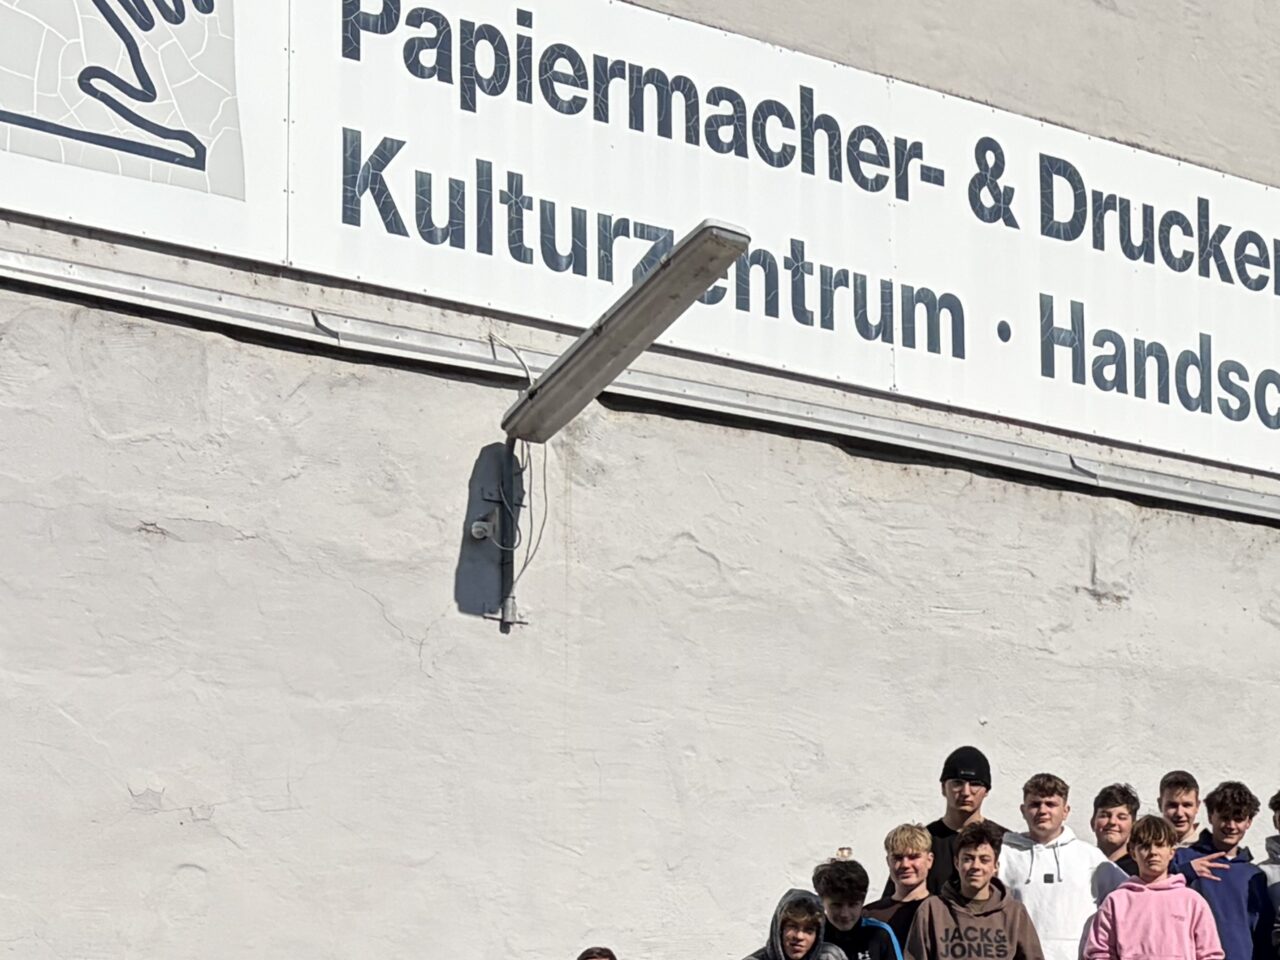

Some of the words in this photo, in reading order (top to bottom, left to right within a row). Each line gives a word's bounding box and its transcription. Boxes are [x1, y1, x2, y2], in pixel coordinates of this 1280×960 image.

[342, 0, 945, 202] Papiermacher-
[968, 137, 1020, 230] &
[940, 942, 1008, 959] JONES
